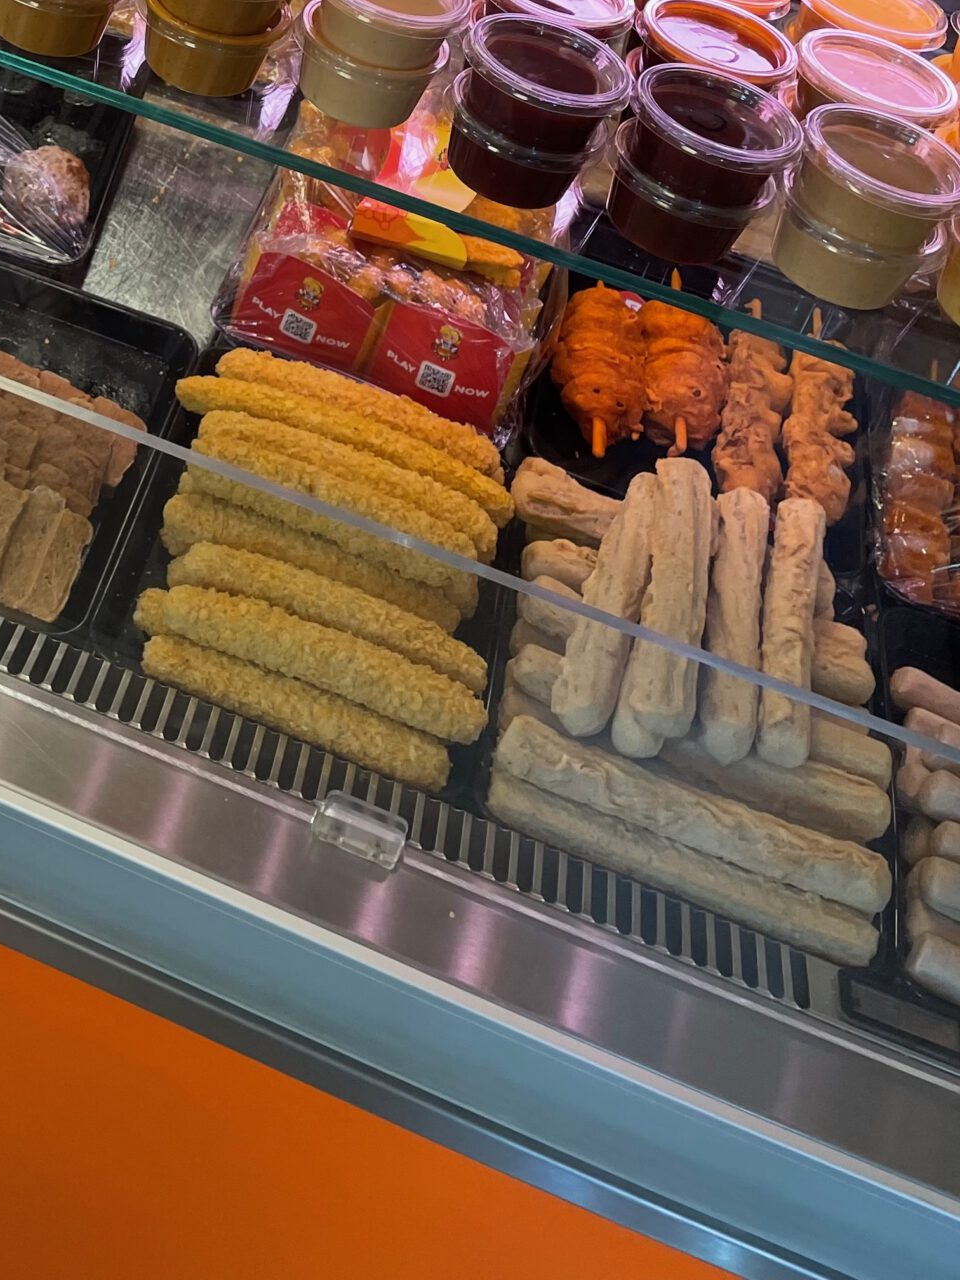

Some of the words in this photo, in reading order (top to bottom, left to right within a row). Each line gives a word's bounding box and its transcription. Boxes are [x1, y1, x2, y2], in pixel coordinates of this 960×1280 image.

[251, 296, 284, 319] PLAY
[316, 334, 351, 349] NOW
[386, 349, 417, 373] PLAY
[454, 385, 491, 398] NOW
